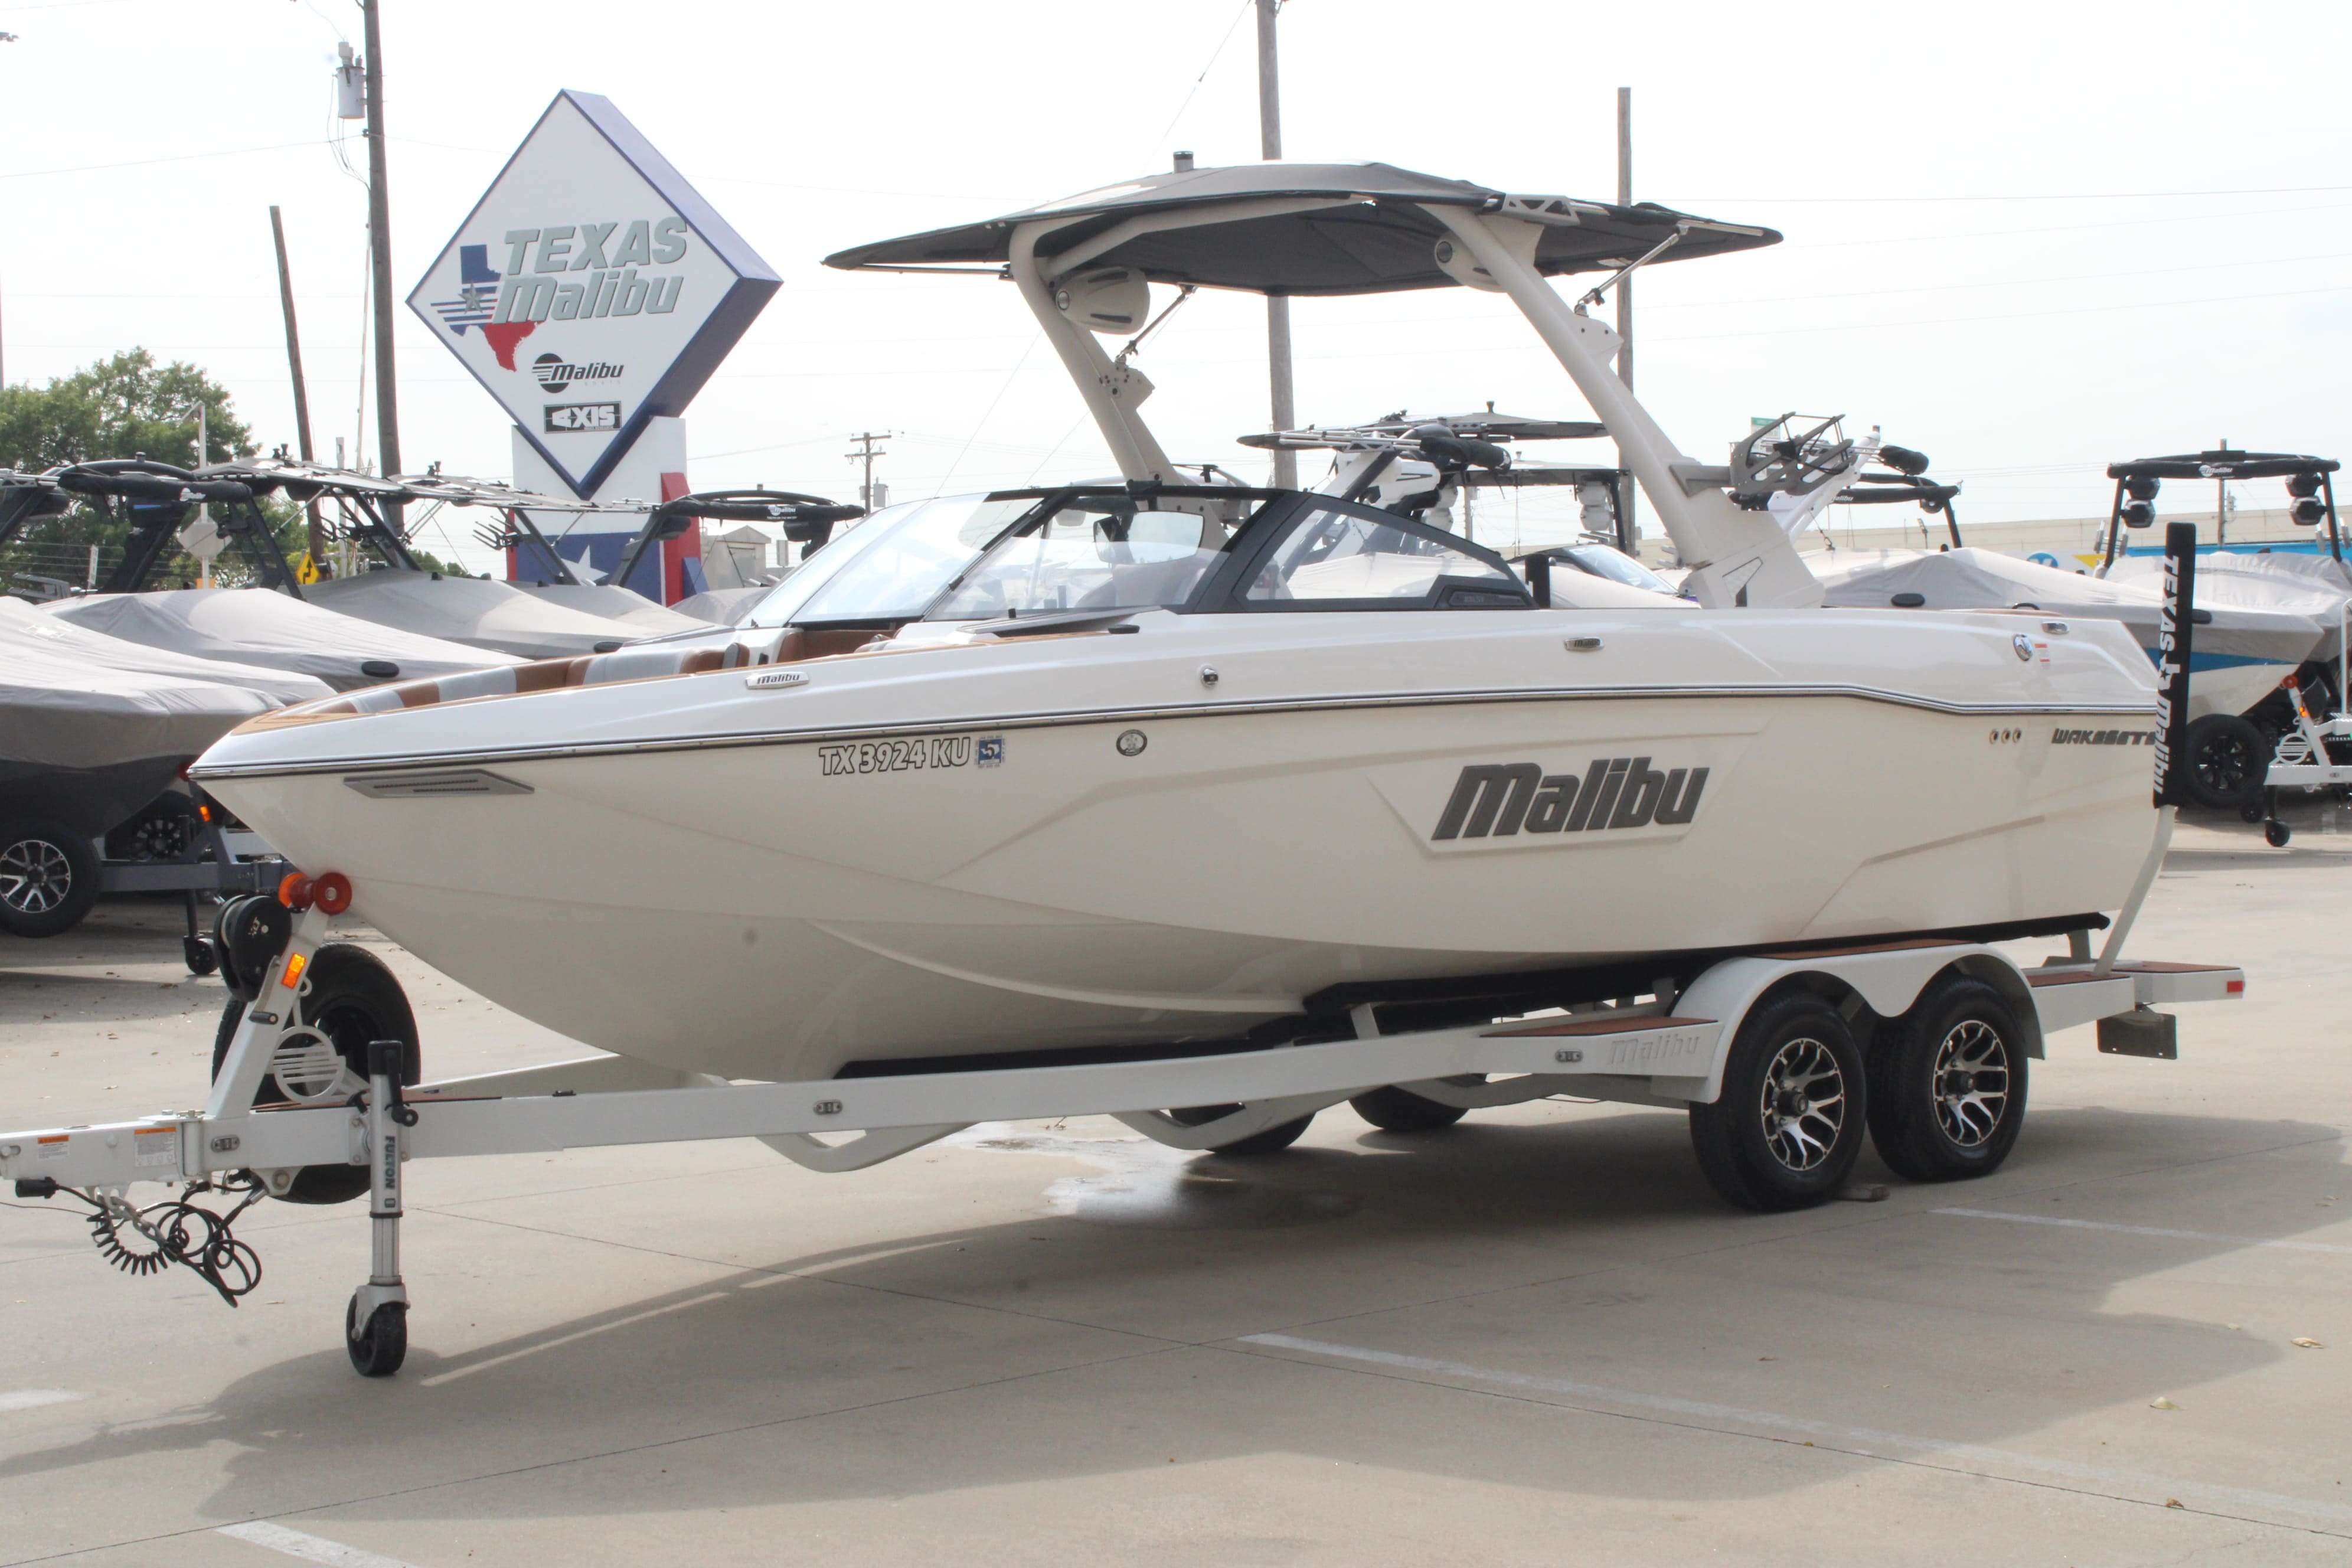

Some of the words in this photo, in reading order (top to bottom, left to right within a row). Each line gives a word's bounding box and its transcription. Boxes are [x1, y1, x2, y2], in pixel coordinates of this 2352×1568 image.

[504, 216, 687, 275] TEXAS
[492, 269, 684, 324] Malibu
[550, 362, 624, 381] Malibu
[552, 405, 616, 428] AXIS
[2160, 555, 2180, 652] TEXAS
[757, 674, 800, 684] Malibu
[819, 745, 856, 775] TX
[859, 740, 926, 773] 3924
[930, 737, 971, 768] KU
[1431, 756, 1710, 841] Malibu
[1611, 1034, 1699, 1064] Malibu
[384, 1135, 396, 1190] FULTON
